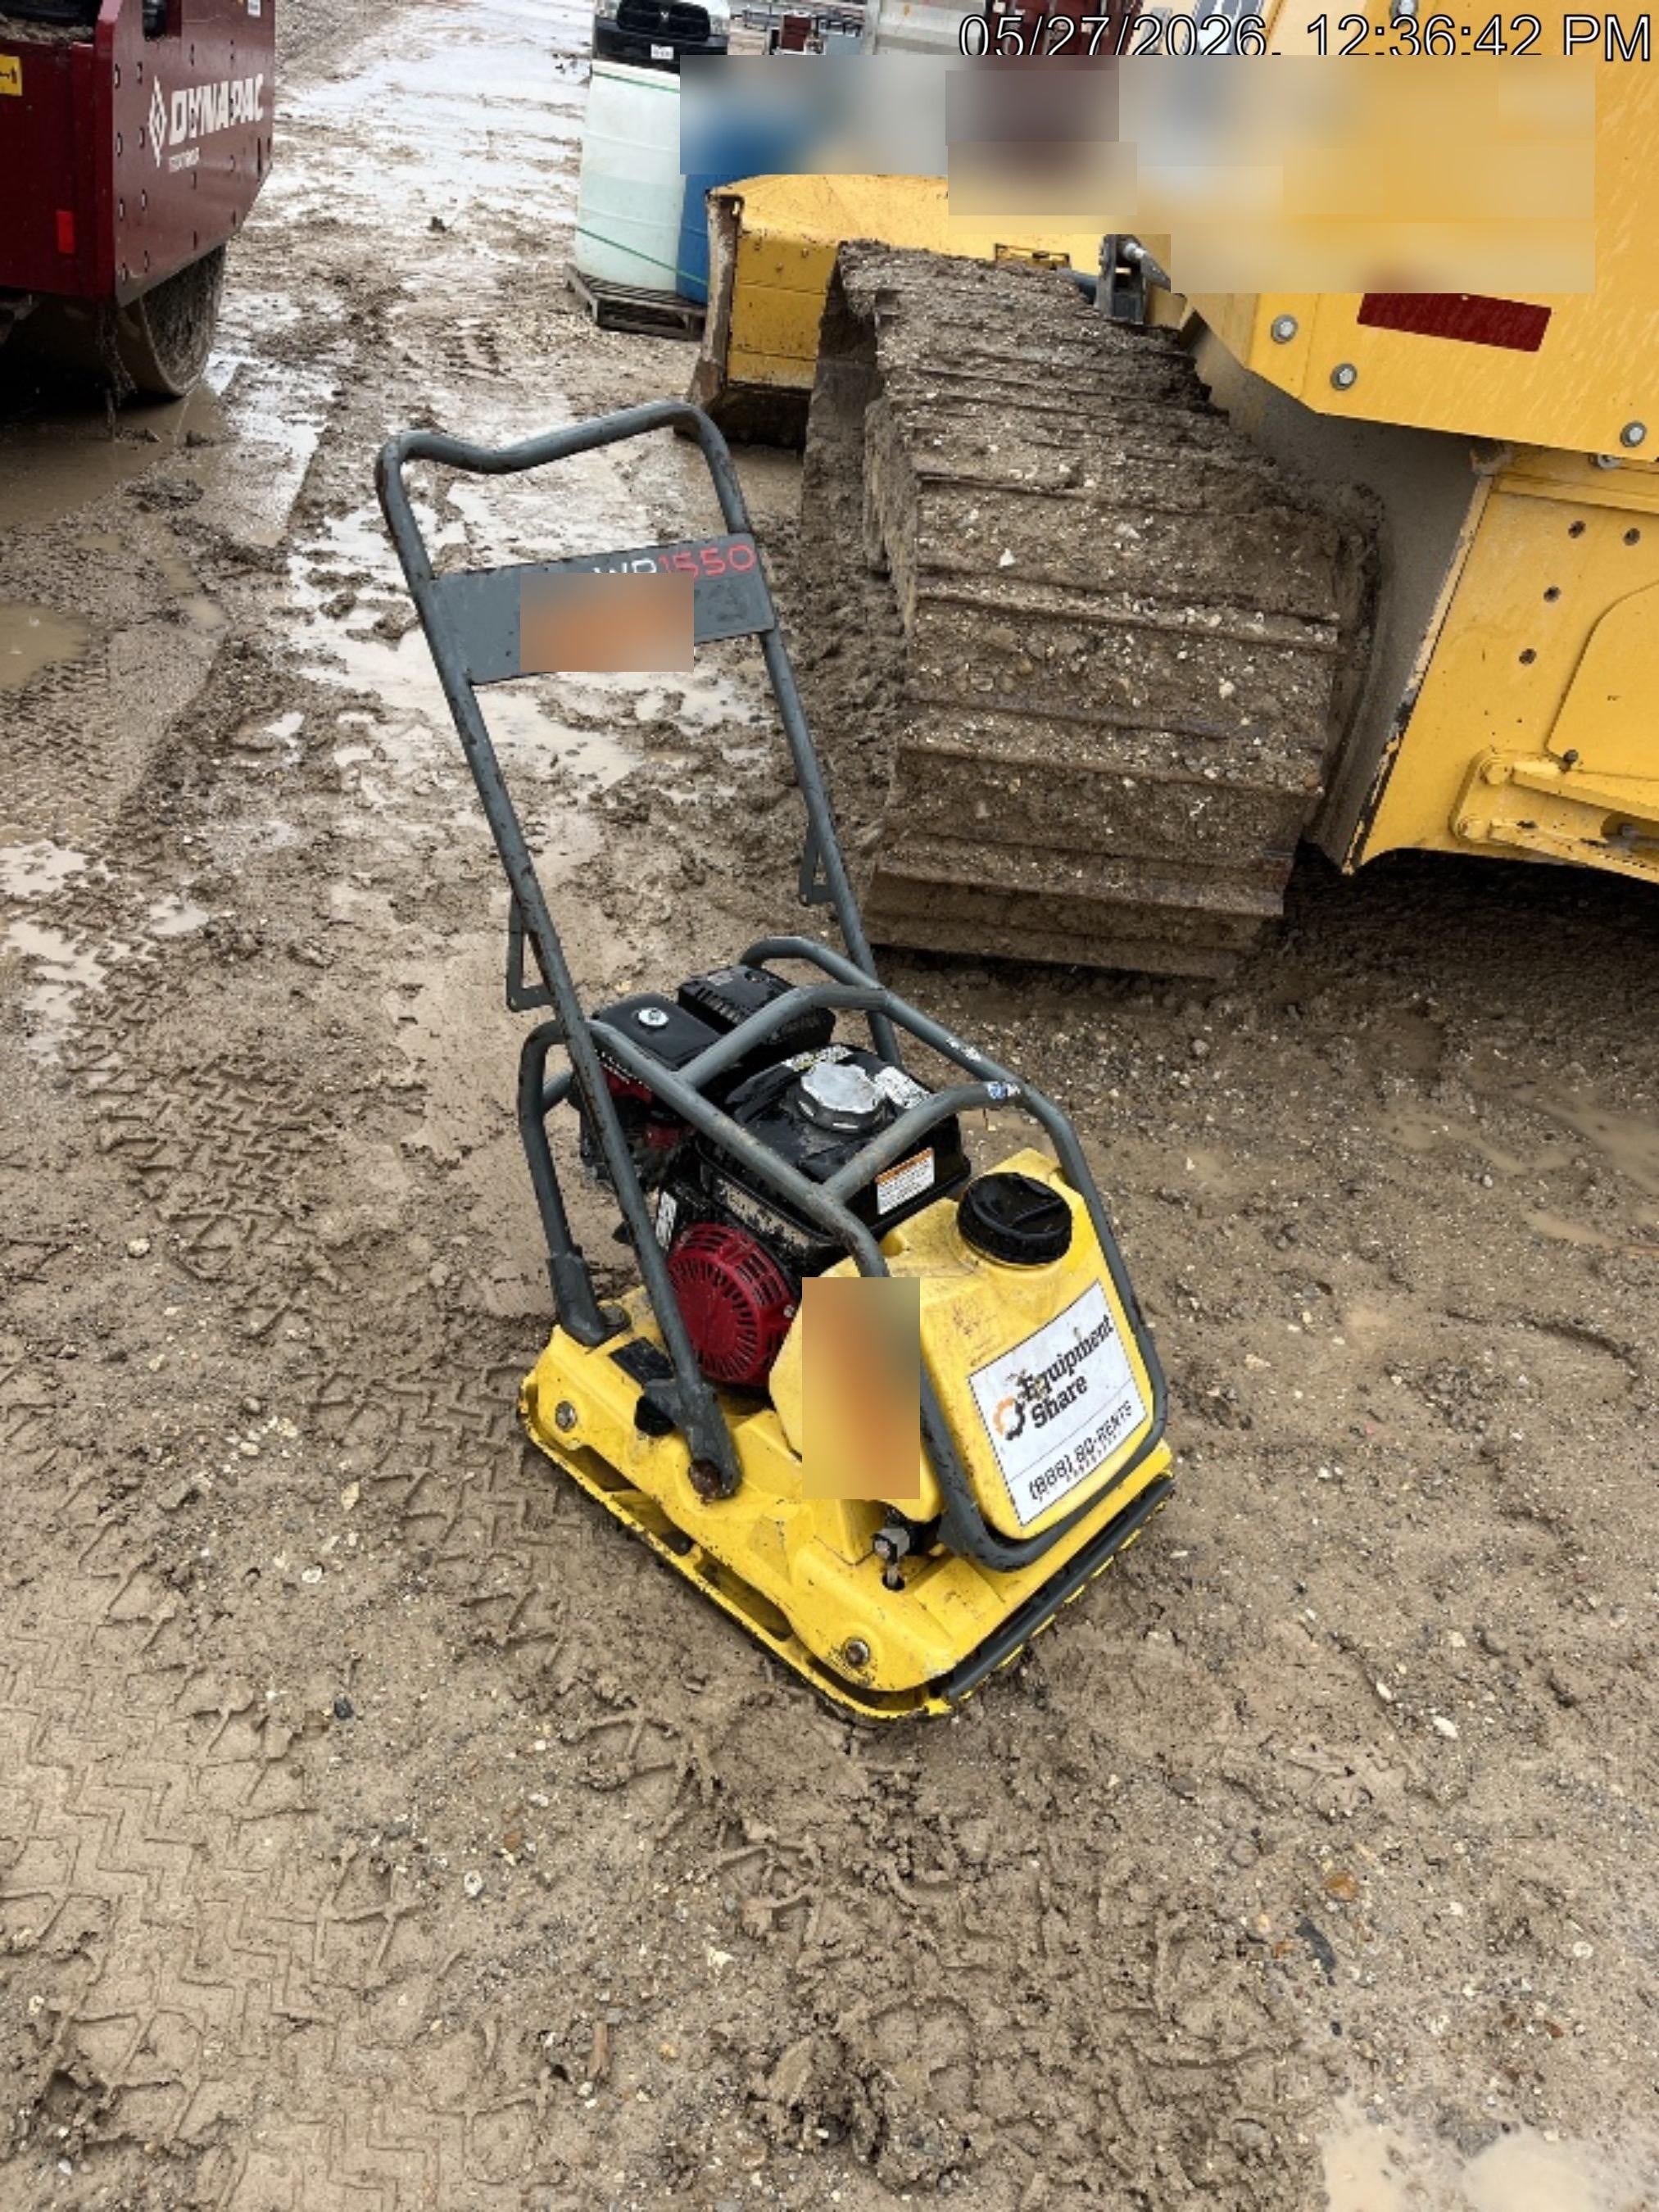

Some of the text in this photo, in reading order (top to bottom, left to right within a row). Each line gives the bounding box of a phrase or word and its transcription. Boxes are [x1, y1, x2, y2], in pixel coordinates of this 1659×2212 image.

[169, 73, 264, 146] DYNAPAC
[1018, 1314, 1113, 1402] Equipment
[1031, 1376, 1088, 1429] Share
[1029, 1453, 1072, 1500] (888)
